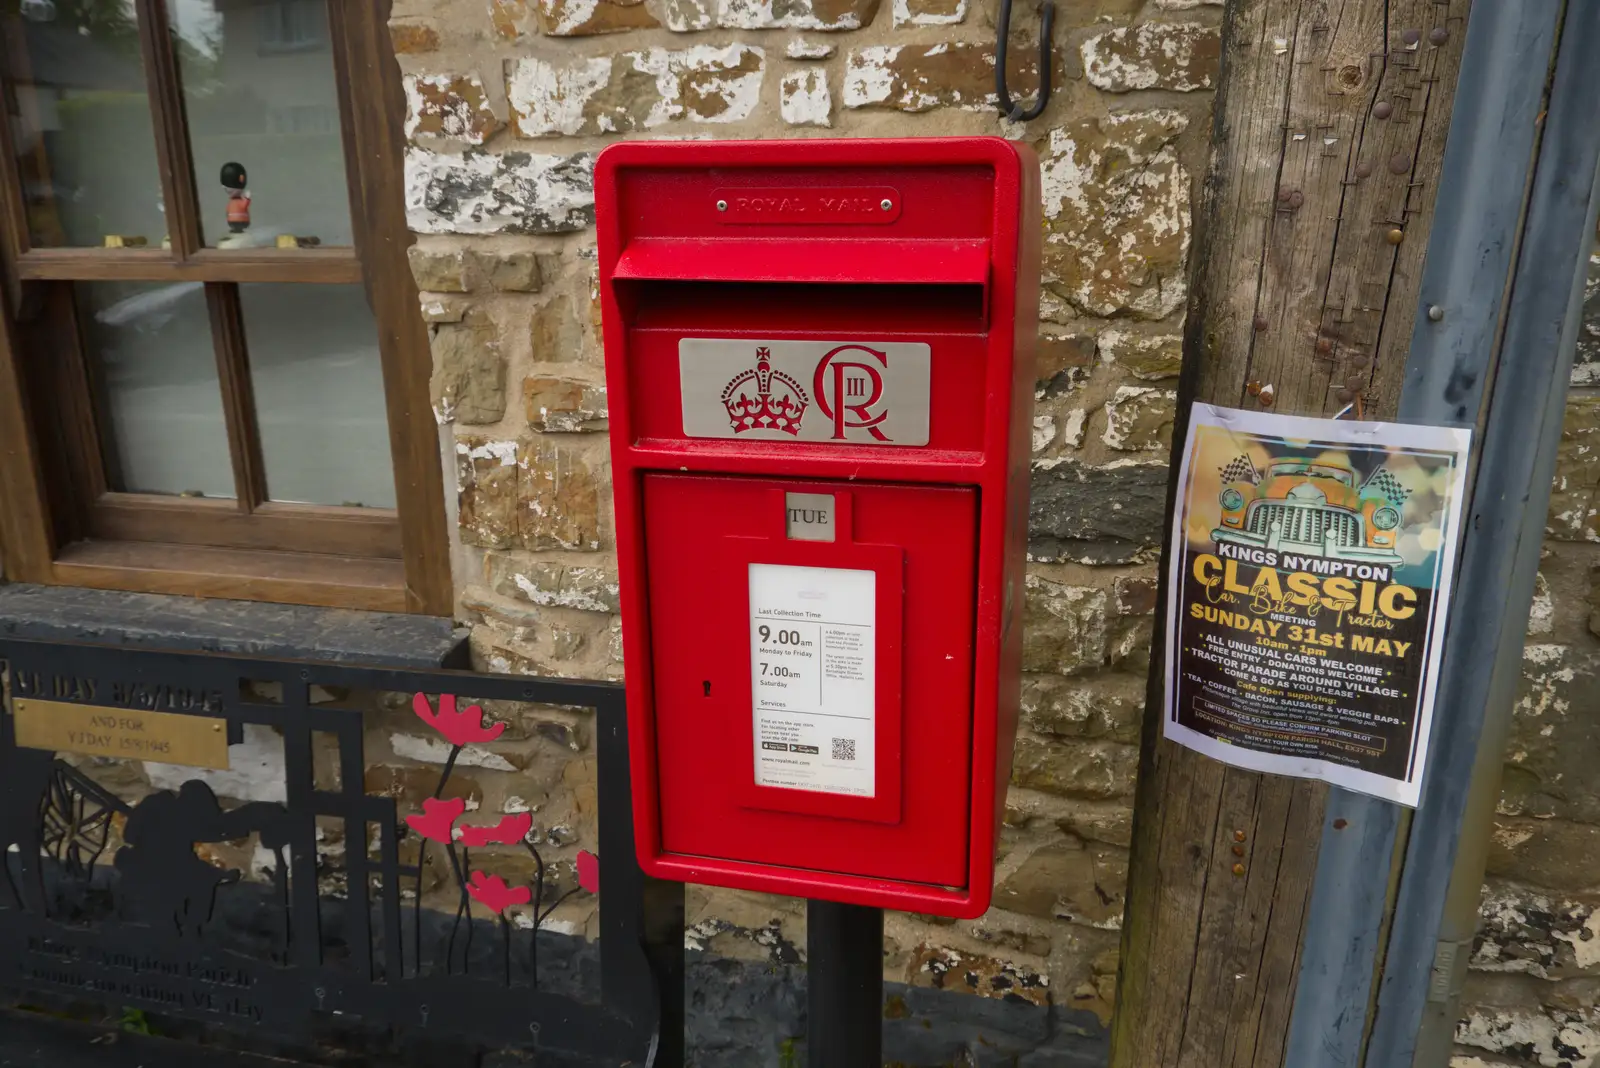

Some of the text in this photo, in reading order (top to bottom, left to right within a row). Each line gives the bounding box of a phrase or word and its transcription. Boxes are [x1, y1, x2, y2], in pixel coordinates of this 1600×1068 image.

[736, 197, 874, 212] ROYAL MAIL
[788, 507, 828, 525] TUE
[1218, 543, 1389, 582] KINGS NYMPTON
[1193, 553, 1418, 620] CLASSIC
[758, 607, 822, 619] Last Collection Time
[1249, 584, 1297, 615] Bike
[1307, 594, 1322, 617] &
[1332, 599, 1394, 630] Tractor
[1190, 602, 1412, 658] SUNDAY 31st MAY
[1270, 613, 1317, 627] MEETING
[758, 624, 813, 647] 9.00am
[1255, 636, 1289, 650] 10am
[1299, 645, 1327, 657] 1pm
[759, 648, 783, 656] Monday
[793, 650, 813, 658] Friday
[1205, 634, 1383, 676] ALL UNUSUAL CARS WELCOME
[1208, 644, 1230, 656] FREE
[1231, 649, 1261, 664] ENTRY
[1268, 659, 1325, 675] DONATIONS
[1327, 669, 1378, 684] WELCOME
[759, 662, 801, 679] 7.00am
[1191, 647, 1400, 699] TRACTOR PARADE AROUND VILLAGE
[759, 679, 788, 688] Saturday
[1223, 667, 1354, 699] COME & GO AS YOU PLEASE
[1236, 680, 1337, 705] Cafe Open supplying:
[760, 699, 786, 708] Services
[1187, 673, 1202, 683] TEA
[1207, 680, 1237, 695] COFFEE
[1244, 691, 1279, 706] BACON,
[1280, 698, 1325, 711] SAUSAGE
[1335, 707, 1372, 719] VEGGIE
[1373, 714, 1400, 725] BAPS
[1231, 701, 1241, 709] The
[89, 714, 145, 732] AND FOR
[1195, 710, 1228, 727] LOCATION:
[1228, 723, 1251, 734] KINGS
[1252, 730, 1290, 740] NYMPTON
[1291, 735, 1320, 744] PARISH
[1204, 701, 1226, 714] LIMITED
[1226, 709, 1250, 721] SPACES
[1262, 719, 1288, 727] PLEASE
[1289, 722, 1320, 732] CONFIRM
[1321, 727, 1352, 738] PARKING
[1353, 733, 1372, 742] SLOT
[1244, 734, 1263, 743] ENTRY
[1271, 739, 1290, 747] YOUR
